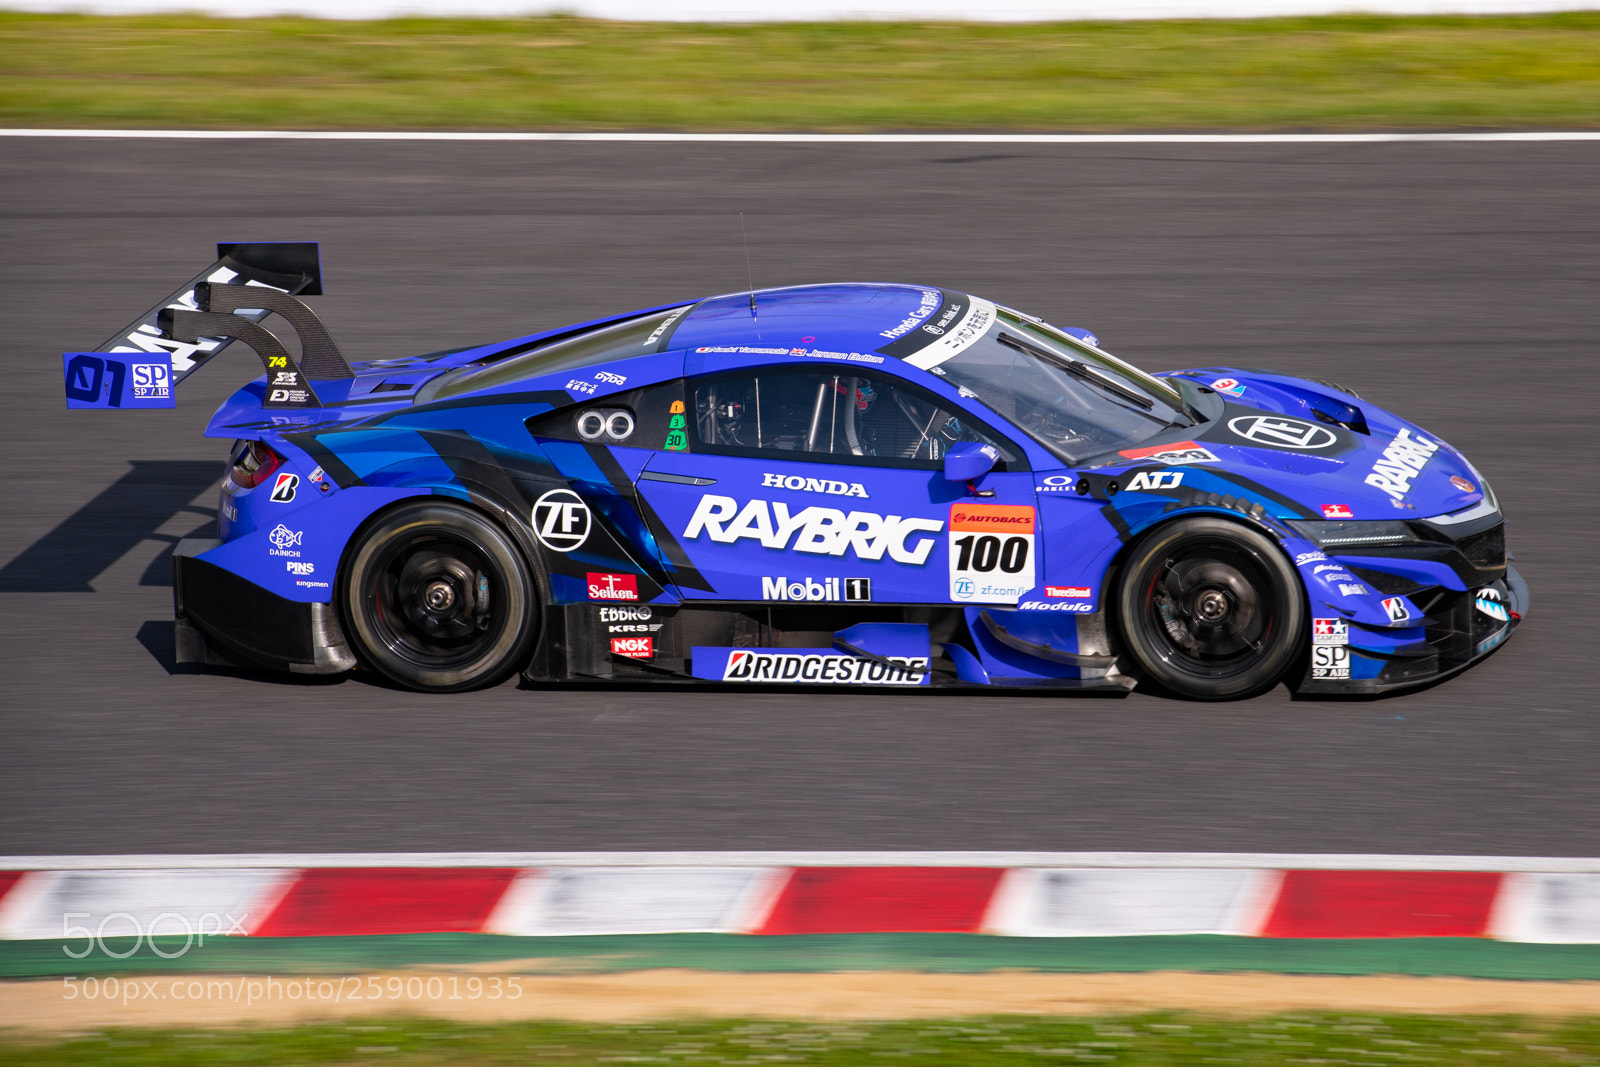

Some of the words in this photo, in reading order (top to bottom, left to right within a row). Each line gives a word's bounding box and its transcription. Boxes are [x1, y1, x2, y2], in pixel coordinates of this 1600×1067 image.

[879, 318, 922, 339] Honda
[909, 305, 935, 318] Cars
[268, 356, 287, 368] 74
[134, 365, 167, 386] SP
[134, 387, 147, 396] SP
[667, 434, 682, 446] 30
[761, 473, 870, 498] HONDA
[536, 498, 588, 542] ZF
[967, 515, 1032, 524] AUTOBACS
[682, 494, 945, 565] RAYBRIG
[269, 548, 301, 557] DAINICHI
[955, 535, 1029, 573] 100
[286, 561, 315, 573] PINS
[761, 576, 840, 601] Mobil
[954, 579, 975, 597] ZF
[1019, 601, 1093, 612] Modulo
[608, 624, 649, 633] KRS
[613, 639, 649, 652] NGK
[1315, 646, 1347, 666] SP
[1312, 668, 1328, 677] SP
[1329, 668, 1350, 677] AIR
